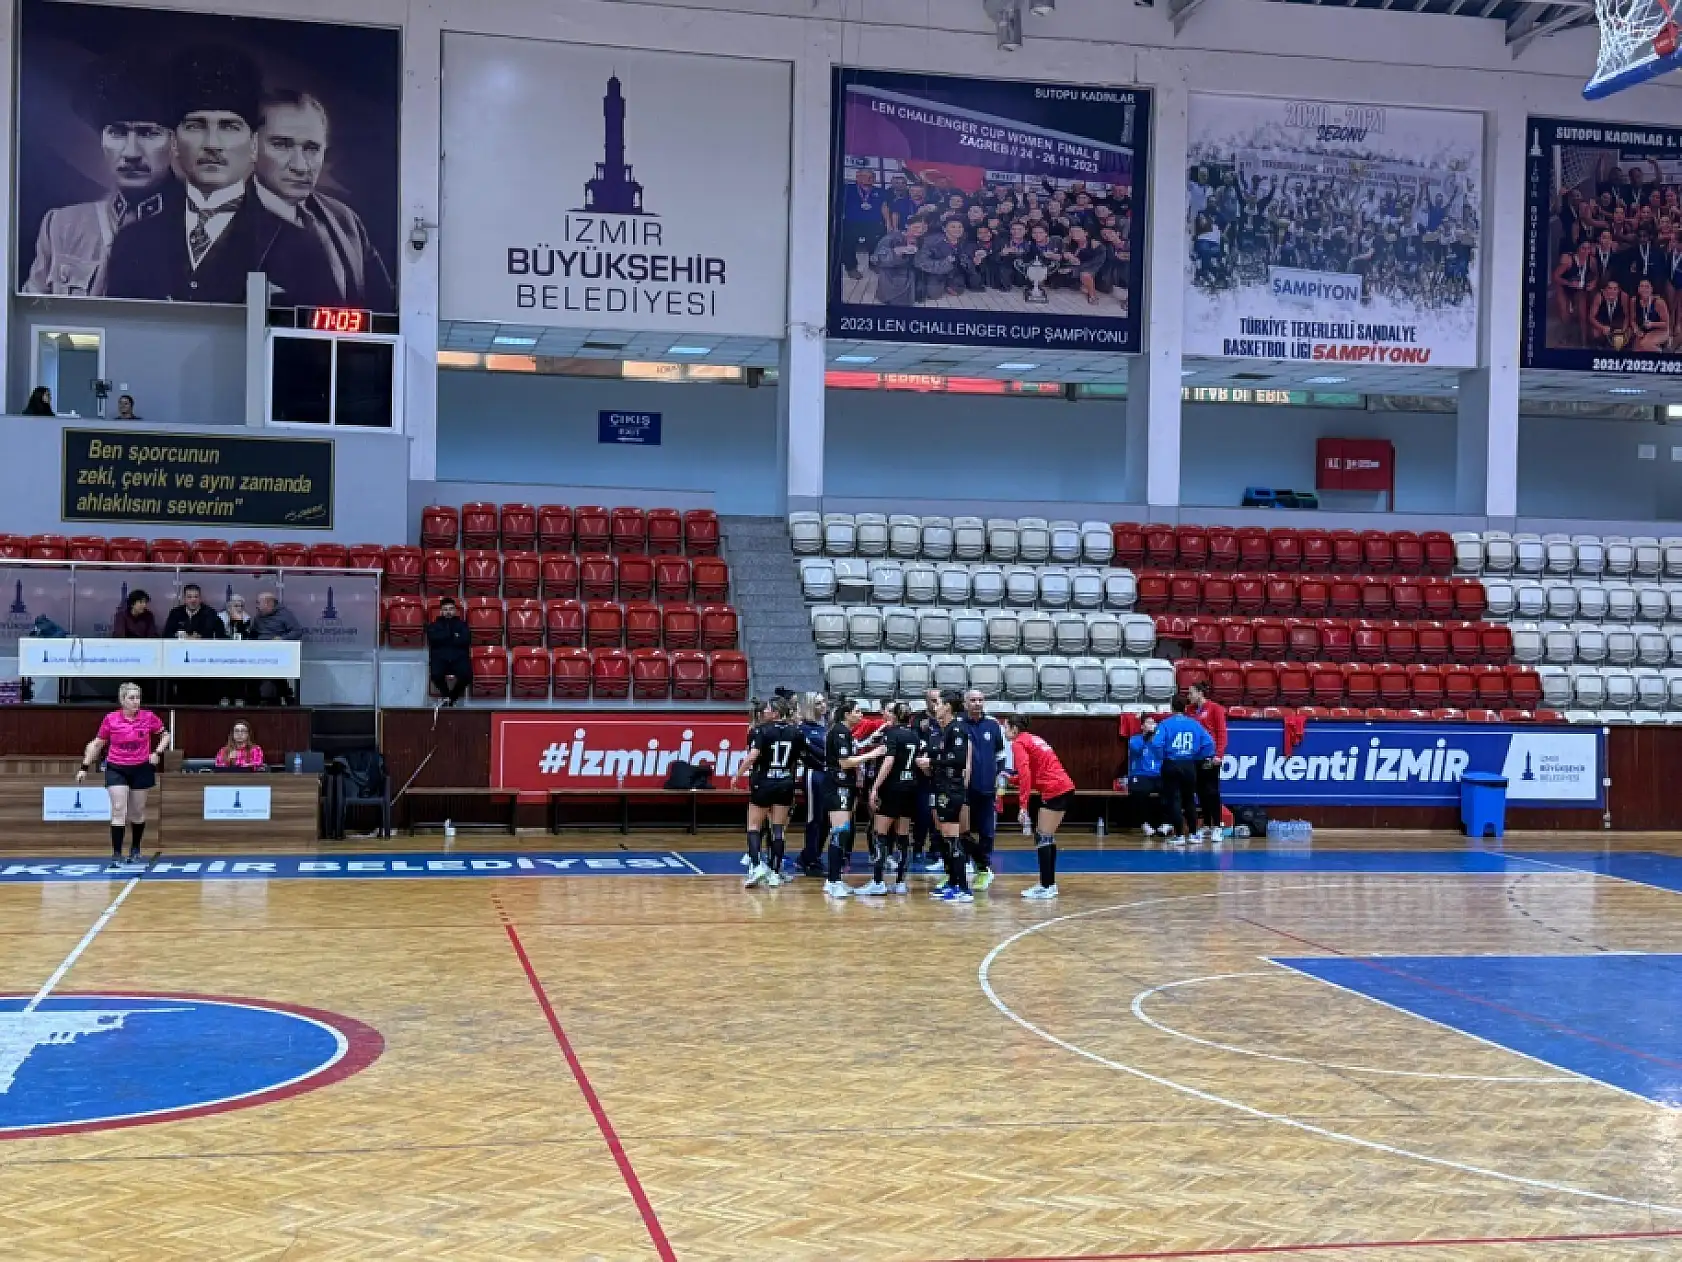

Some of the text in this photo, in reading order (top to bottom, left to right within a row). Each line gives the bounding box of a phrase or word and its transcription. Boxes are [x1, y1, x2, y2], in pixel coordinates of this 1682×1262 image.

[1035, 87, 1135, 103] SUTOPU KADINLAR
[871, 100, 895, 115] LEN
[897, 108, 978, 135] CHALLENGER
[980, 126, 1005, 140] CUP
[1007, 131, 1052, 150] WOMEN
[1057, 143, 1091, 159] FINAL
[1316, 124, 1368, 142] SEZONU
[1556, 126, 1601, 141] SUTOPU
[1604, 130, 1663, 146] KADINLAR
[959, 134, 1009, 154] ZAGREB
[564, 214, 662, 246] İZMİR
[507, 243, 726, 284] BÜYÜKŞEHİR
[516, 284, 716, 317] BELEDİYESİ
[1273, 277, 1359, 301] ŞAMPİYON
[313, 310, 361, 331] 17:03
[841, 317, 1129, 344] 2023 LEN CHALLENGER CUP ŞAMPİYONU
[1240, 316, 1417, 343] TÜRKİYE TEKERLEKLİ SANDALYE
[1223, 338, 1287, 358] BASKETBOL
[88, 439, 220, 465] Ben sporcunun
[77, 465, 312, 494] zeki, çevik ve aynı zamanda
[76, 493, 161, 514] ahlaklısını
[770, 741, 792, 767] 17
[906, 744, 916, 770] 7
[1263, 746, 1359, 781] kenti
[1364, 737, 1469, 782] İZMİR
[298, 857, 685, 871] BELEDİYESİ
